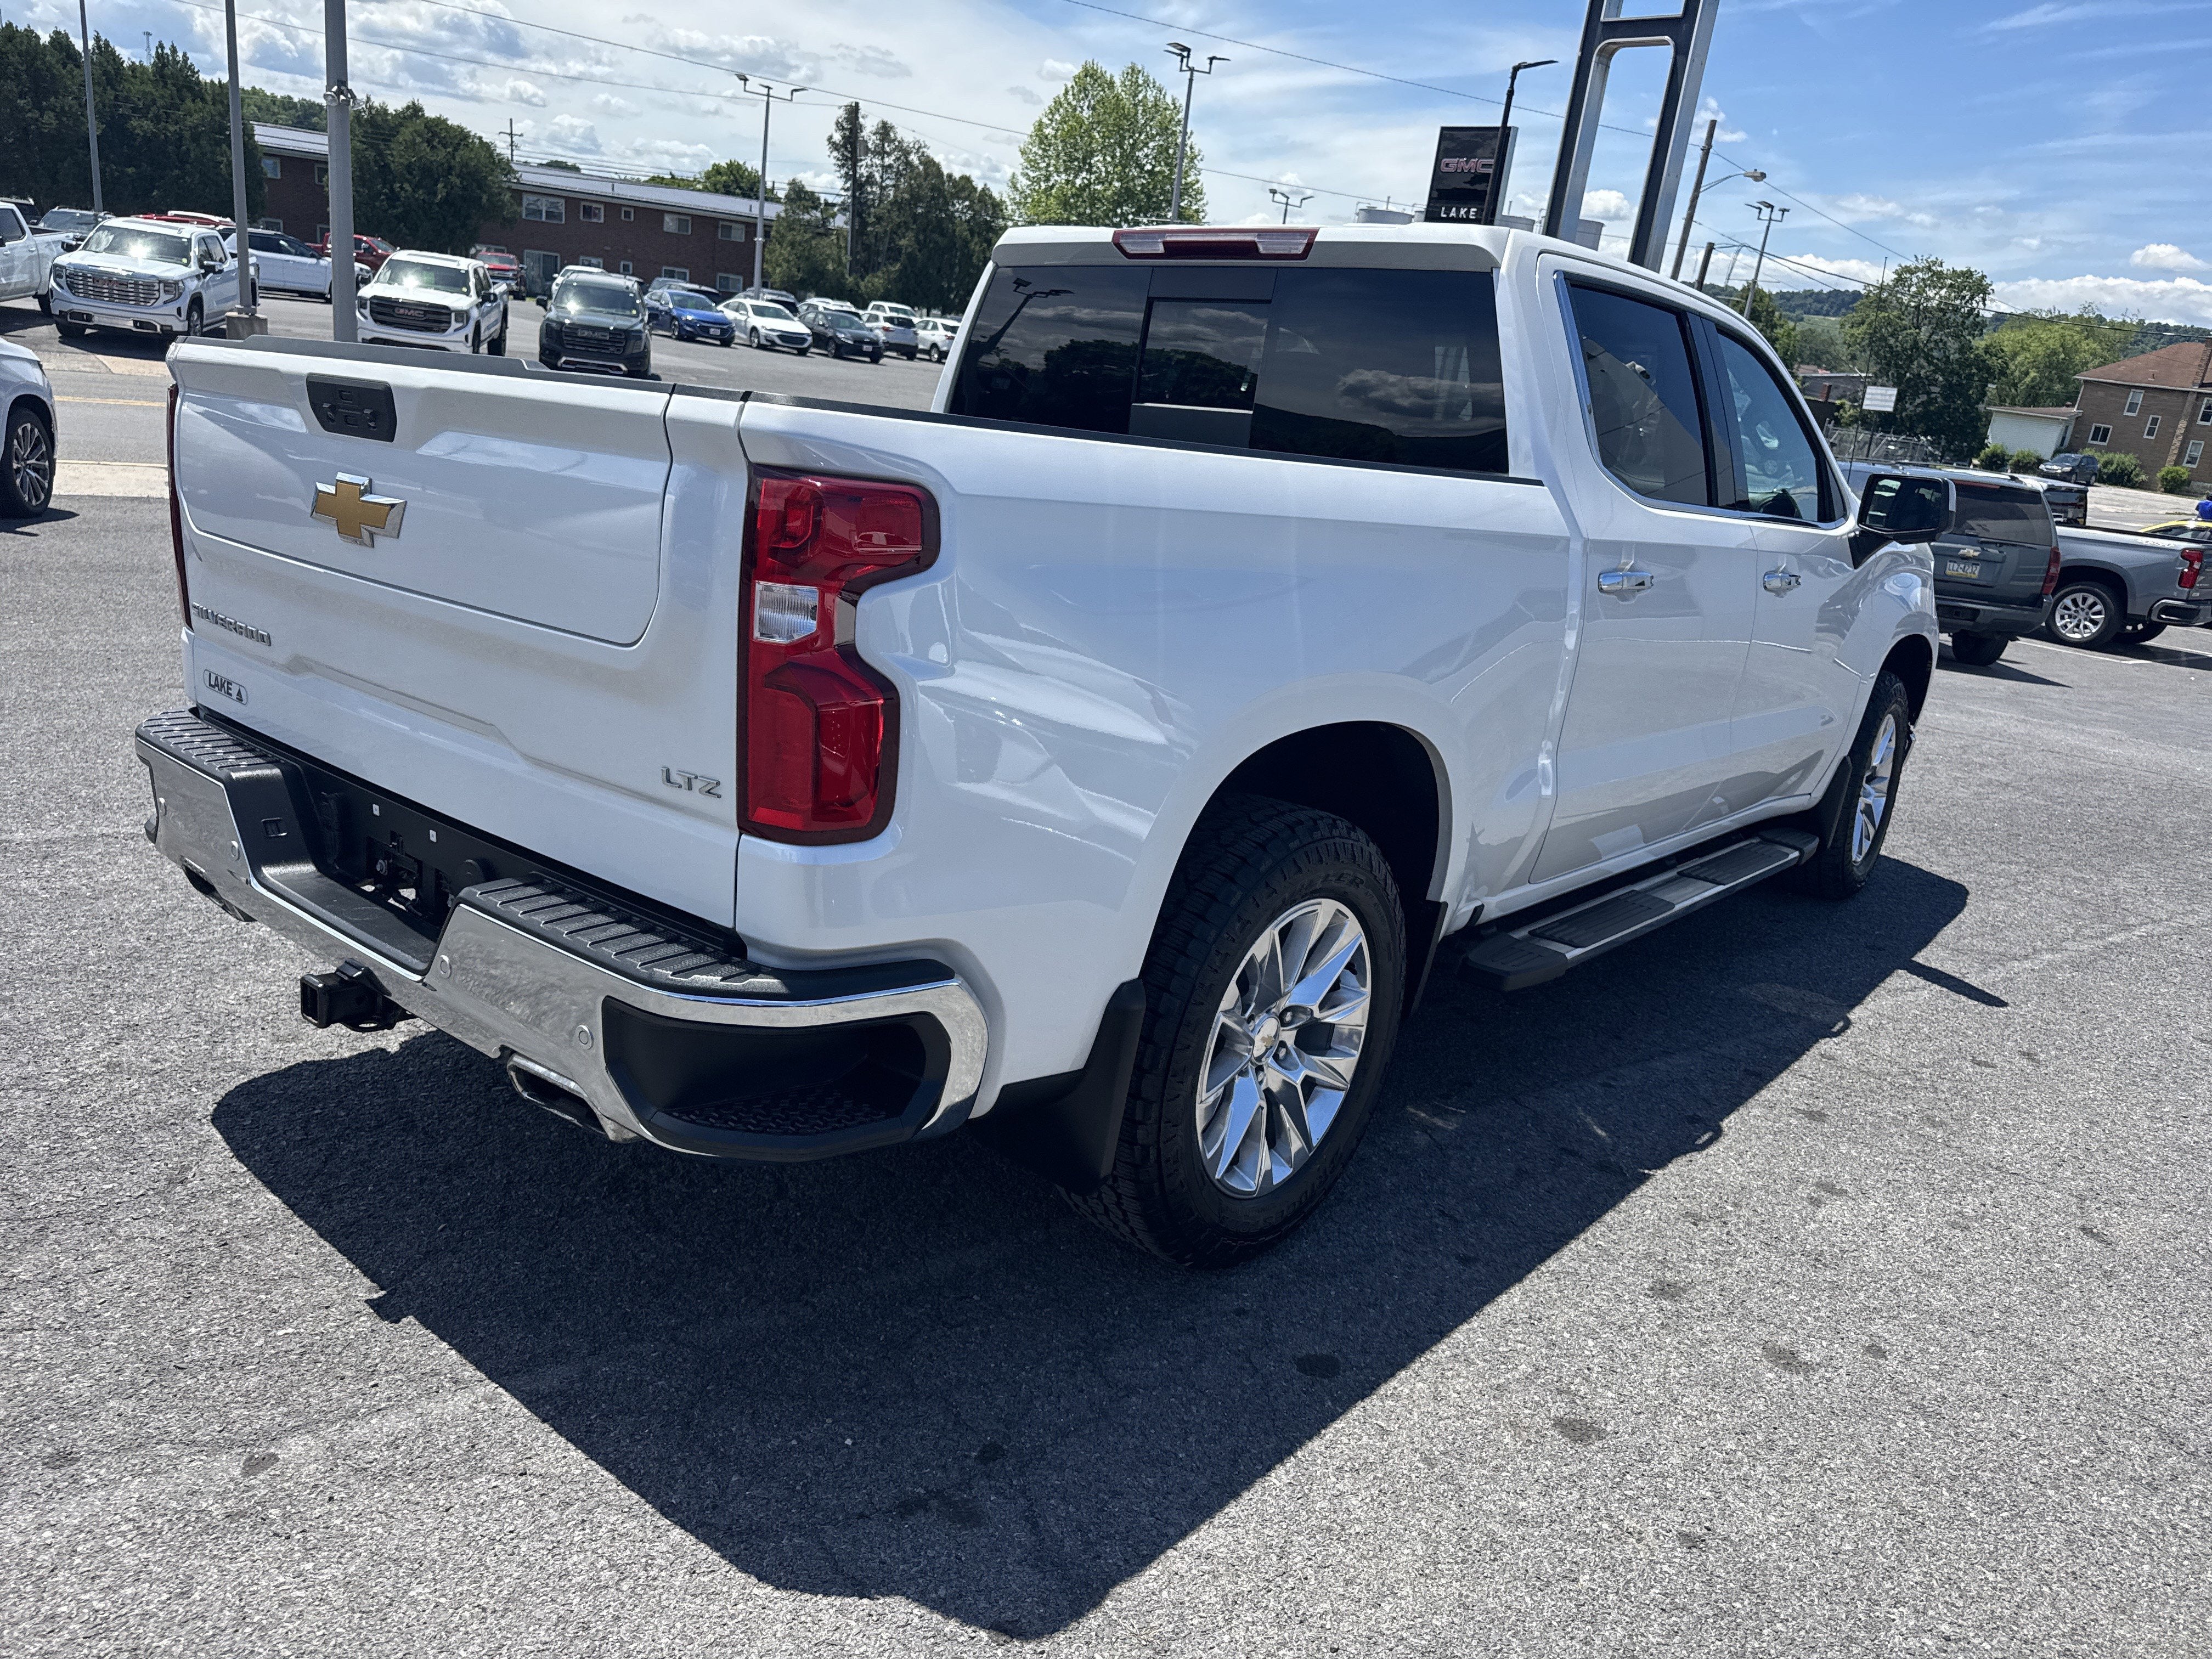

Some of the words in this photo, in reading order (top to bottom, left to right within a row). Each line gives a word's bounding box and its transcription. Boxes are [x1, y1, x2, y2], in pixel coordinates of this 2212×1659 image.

[1440, 157, 1495, 173] GMC
[1440, 206, 1477, 219] LAKE
[394, 308, 424, 318] GMC
[208, 673, 233, 697] LAKE
[661, 766, 721, 799] LTZ
